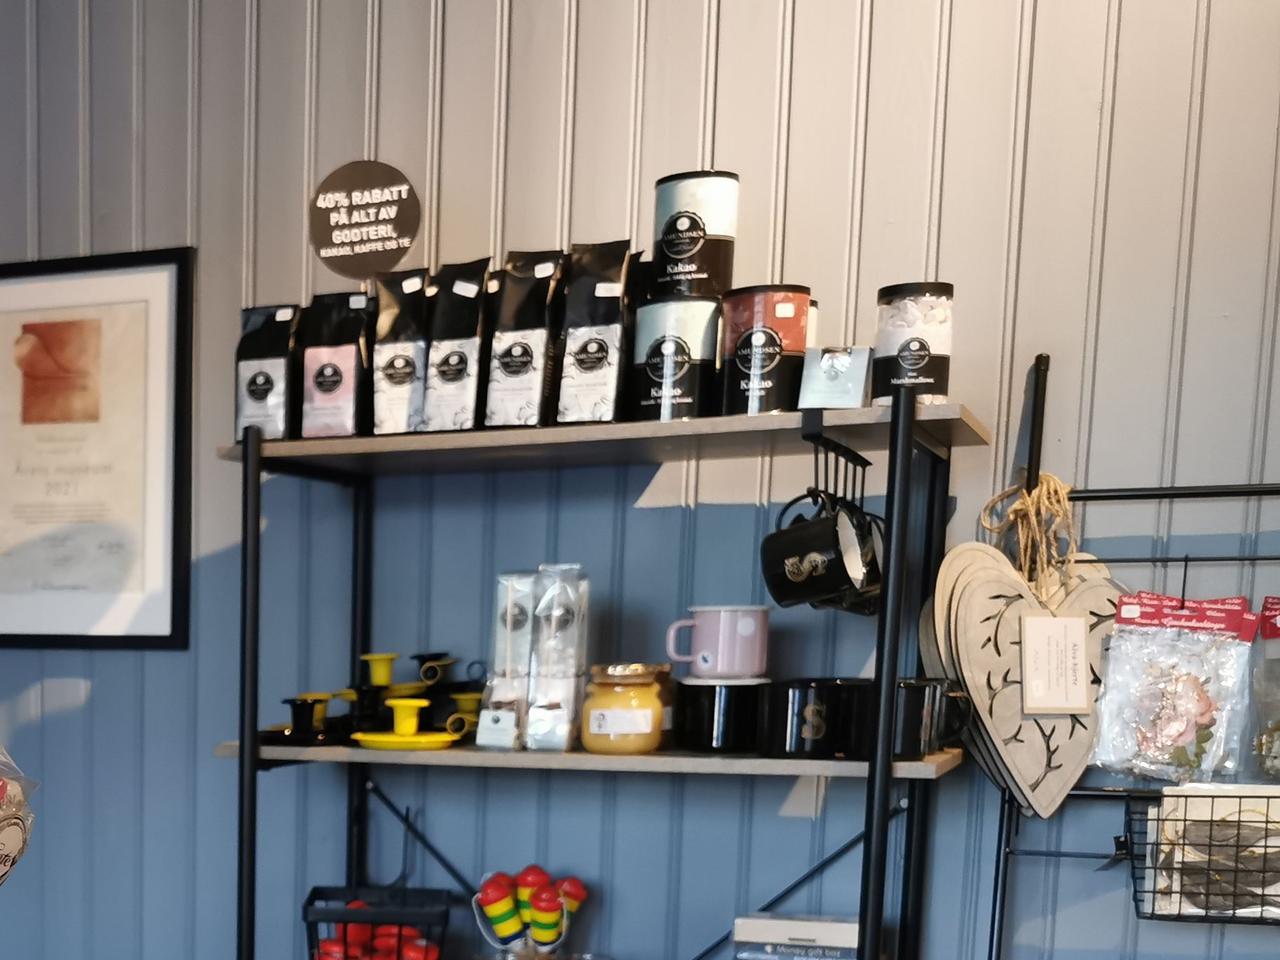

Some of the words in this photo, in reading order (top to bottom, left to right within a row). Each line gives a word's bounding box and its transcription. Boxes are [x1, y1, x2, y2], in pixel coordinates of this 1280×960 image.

[316, 191, 350, 208] 40%
[351, 184, 410, 206] RABATT
[329, 207, 350, 226] PÅ
[351, 209, 377, 224] ALT
[378, 205, 398, 221] AV
[332, 224, 397, 244] GODTERI,
[399, 237, 411, 248] TE
